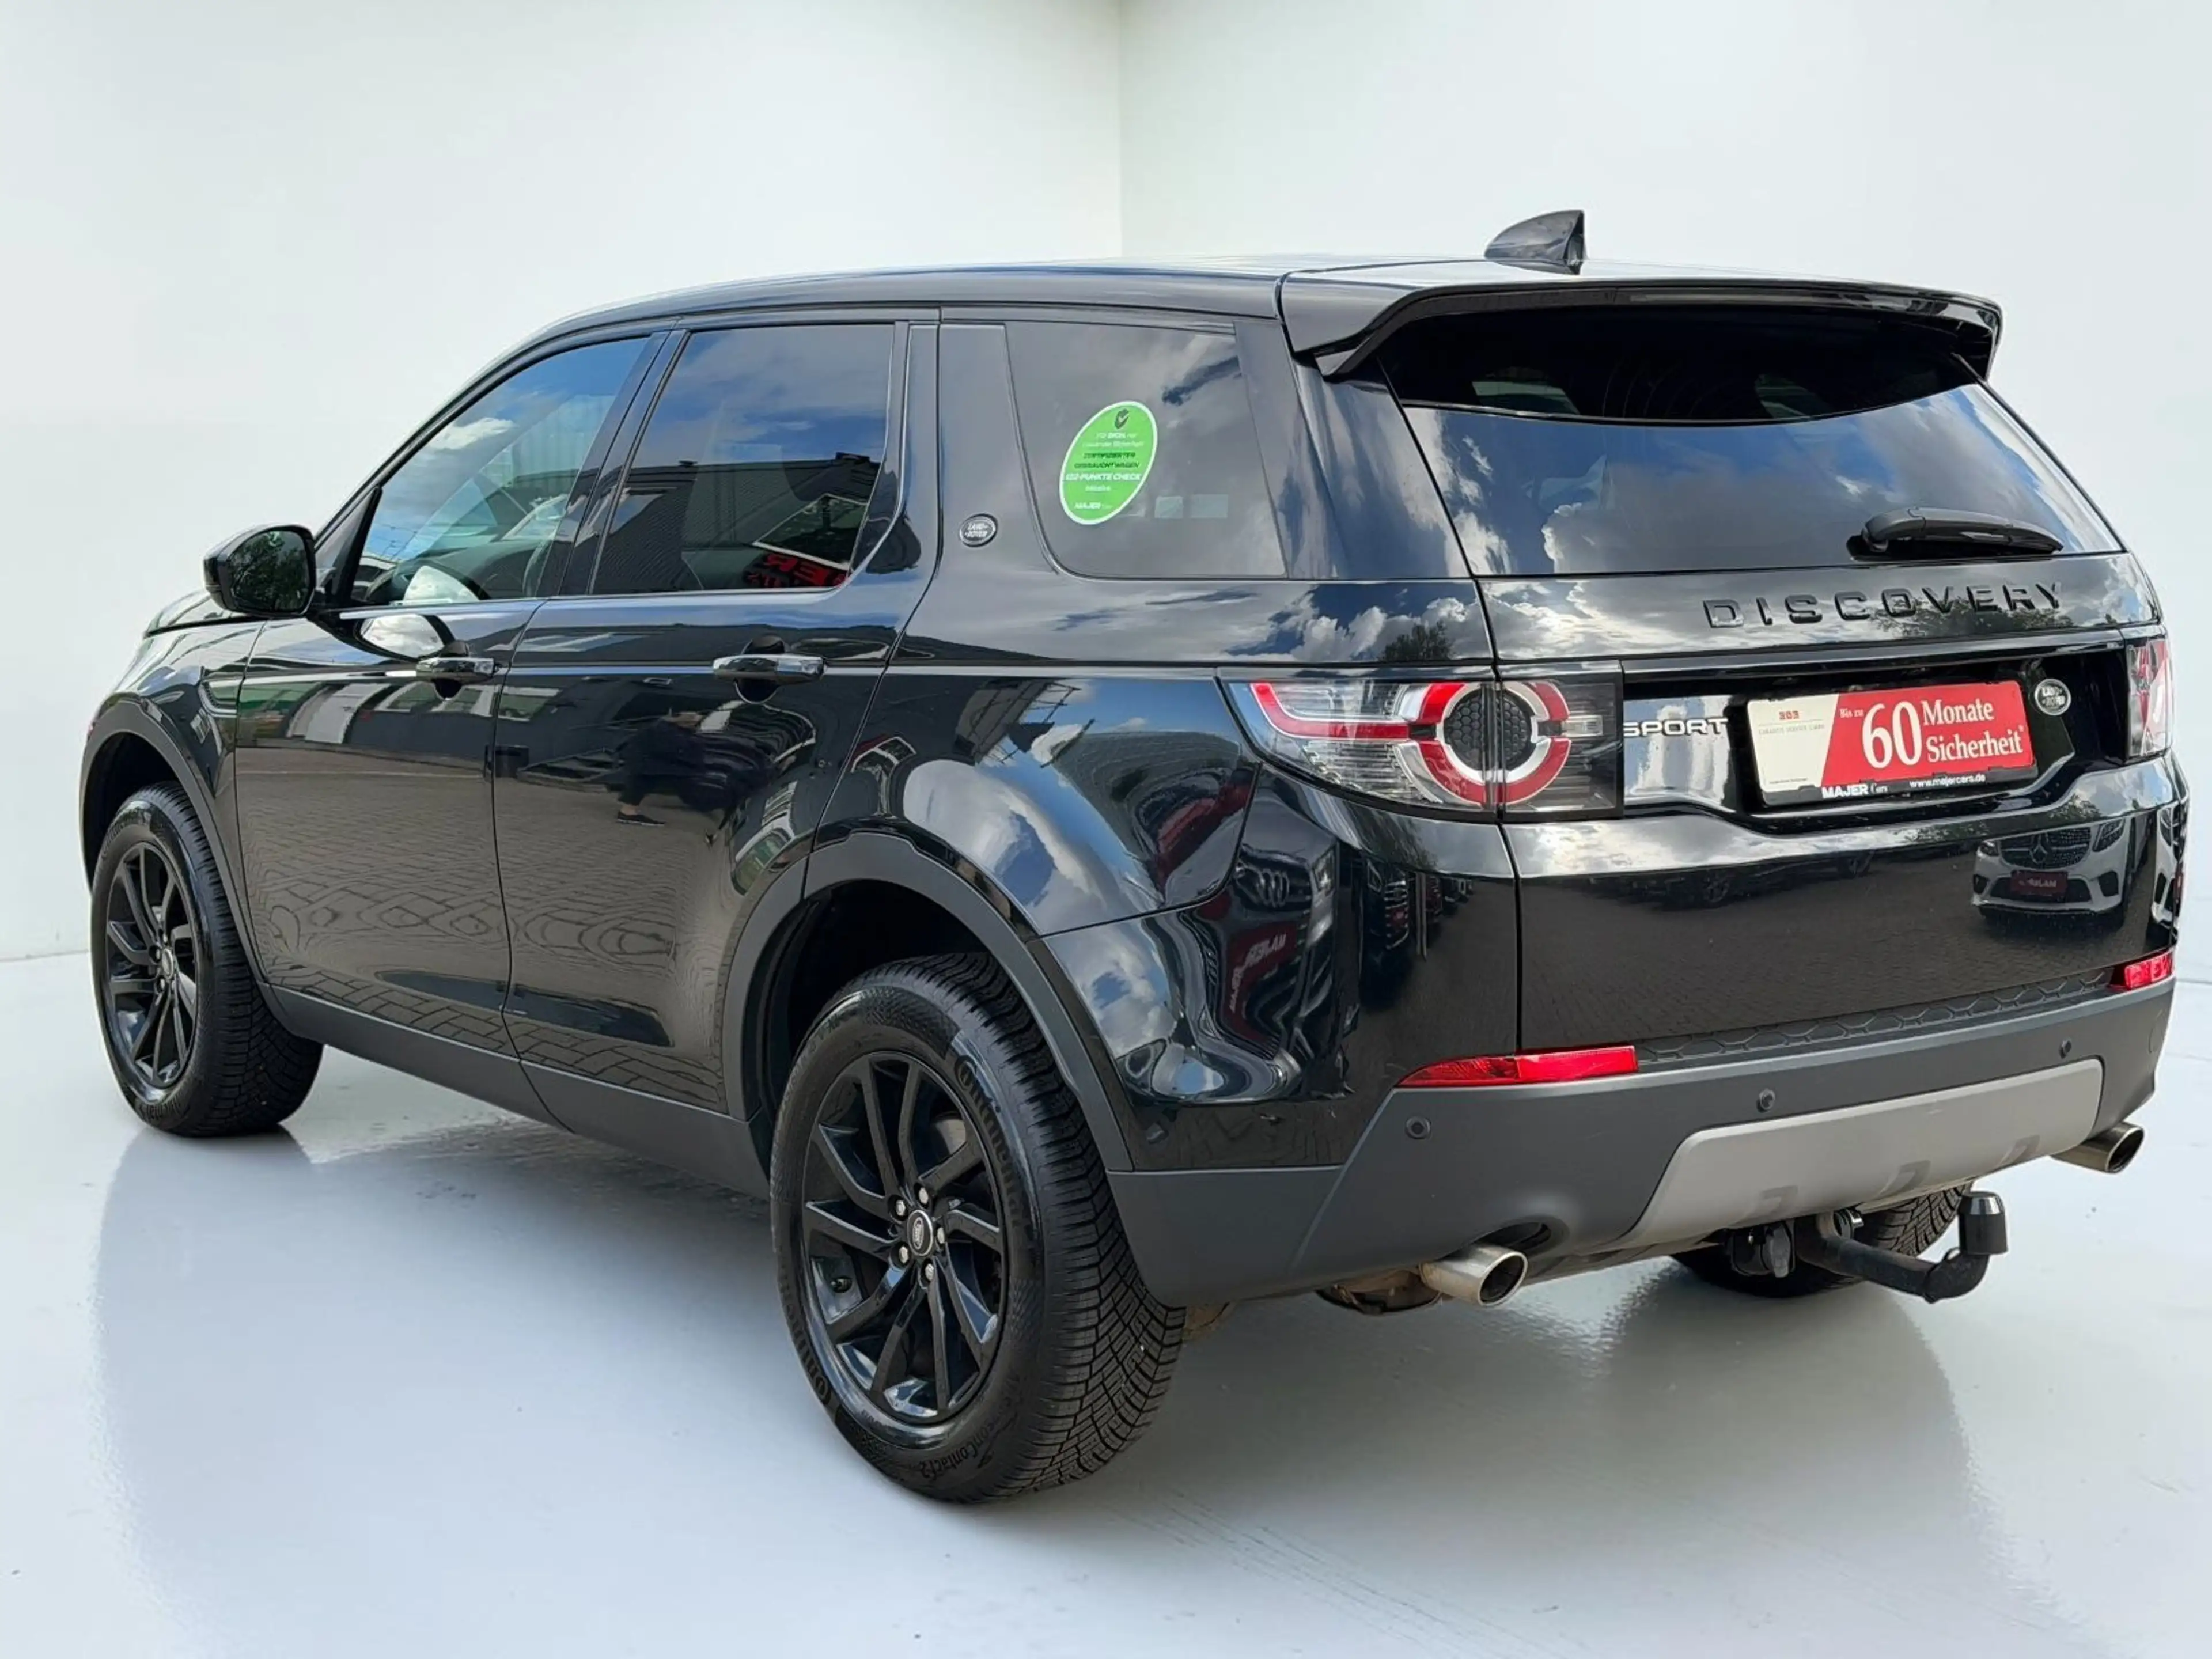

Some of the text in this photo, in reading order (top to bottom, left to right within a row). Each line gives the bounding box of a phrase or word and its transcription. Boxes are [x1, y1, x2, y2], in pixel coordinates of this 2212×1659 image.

[1702, 581, 2062, 629] DISCOVERY
[1623, 717, 1728, 737] SPORT
[1840, 698, 1994, 768] Bis zu 60 Monate
[1821, 783, 1869, 798] MAJER
[1909, 773, 1986, 788] www.majercars.de
